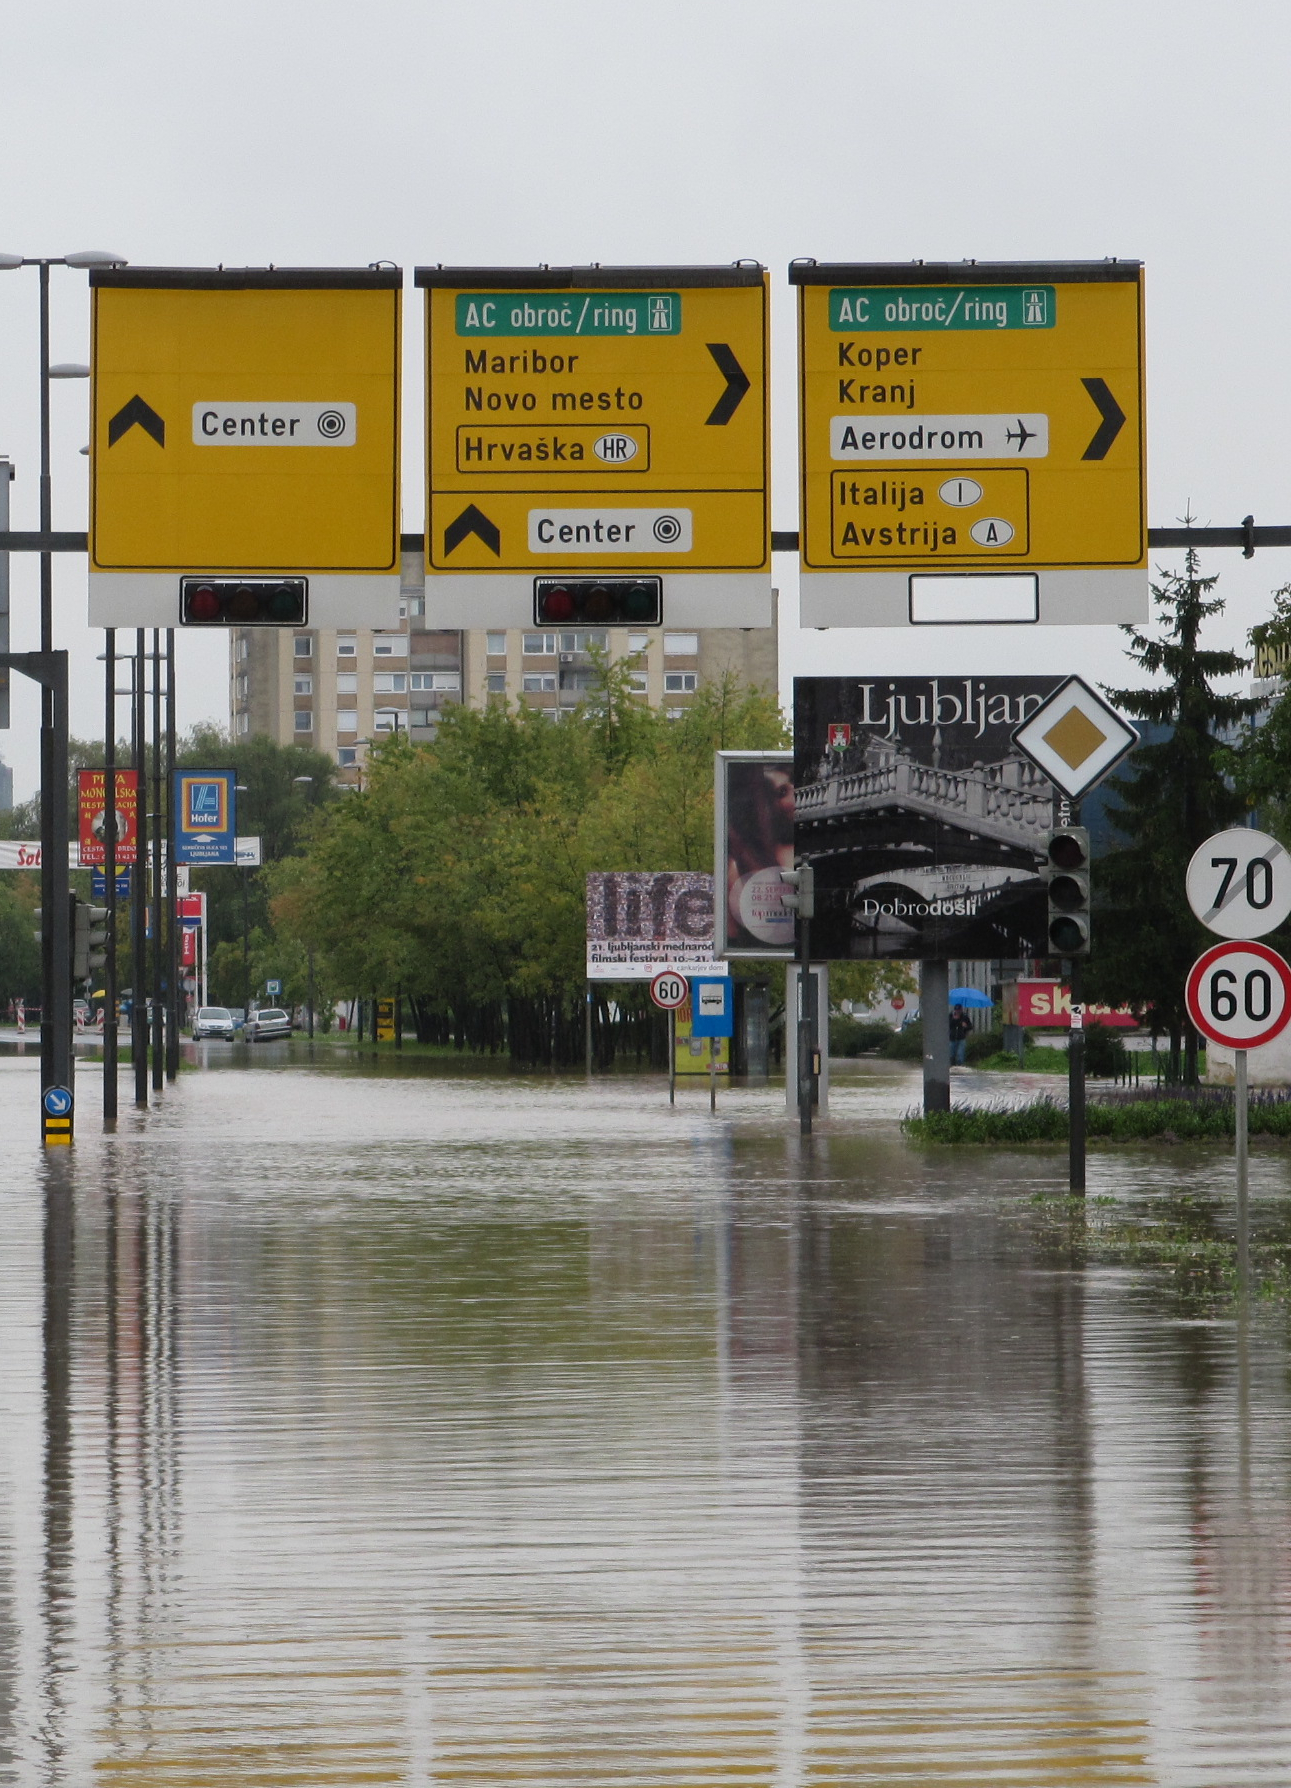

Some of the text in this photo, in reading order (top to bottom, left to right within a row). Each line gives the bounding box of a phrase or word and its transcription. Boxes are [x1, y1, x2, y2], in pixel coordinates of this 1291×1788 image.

[465, 302, 496, 328] AC
[839, 298, 869, 323] AC
[465, 349, 579, 374] Maribor
[838, 342, 922, 371] Koper
[465, 387, 643, 411] Novo mesto
[839, 379, 916, 409] Kranj
[201, 411, 301, 437] Center
[465, 437, 628, 461] Hrvaška HR
[840, 425, 984, 450] Aerodrom
[840, 481, 963, 512] Italija I
[537, 518, 636, 544] Center
[841, 521, 999, 552] Avstrija A
[858, 678, 1045, 740] Ljubljan
[191, 813, 218, 823] Hofer
[17, 844, 42, 866] Šol
[1211, 857, 1273, 910] 70
[591, 953, 627, 962] filmski
[629, 953, 668, 962] festival
[608, 940, 660, 953] ljubljanski
[662, 941, 714, 951] mednarod
[659, 980, 680, 1000] 60
[1210, 969, 1272, 1021] 60
